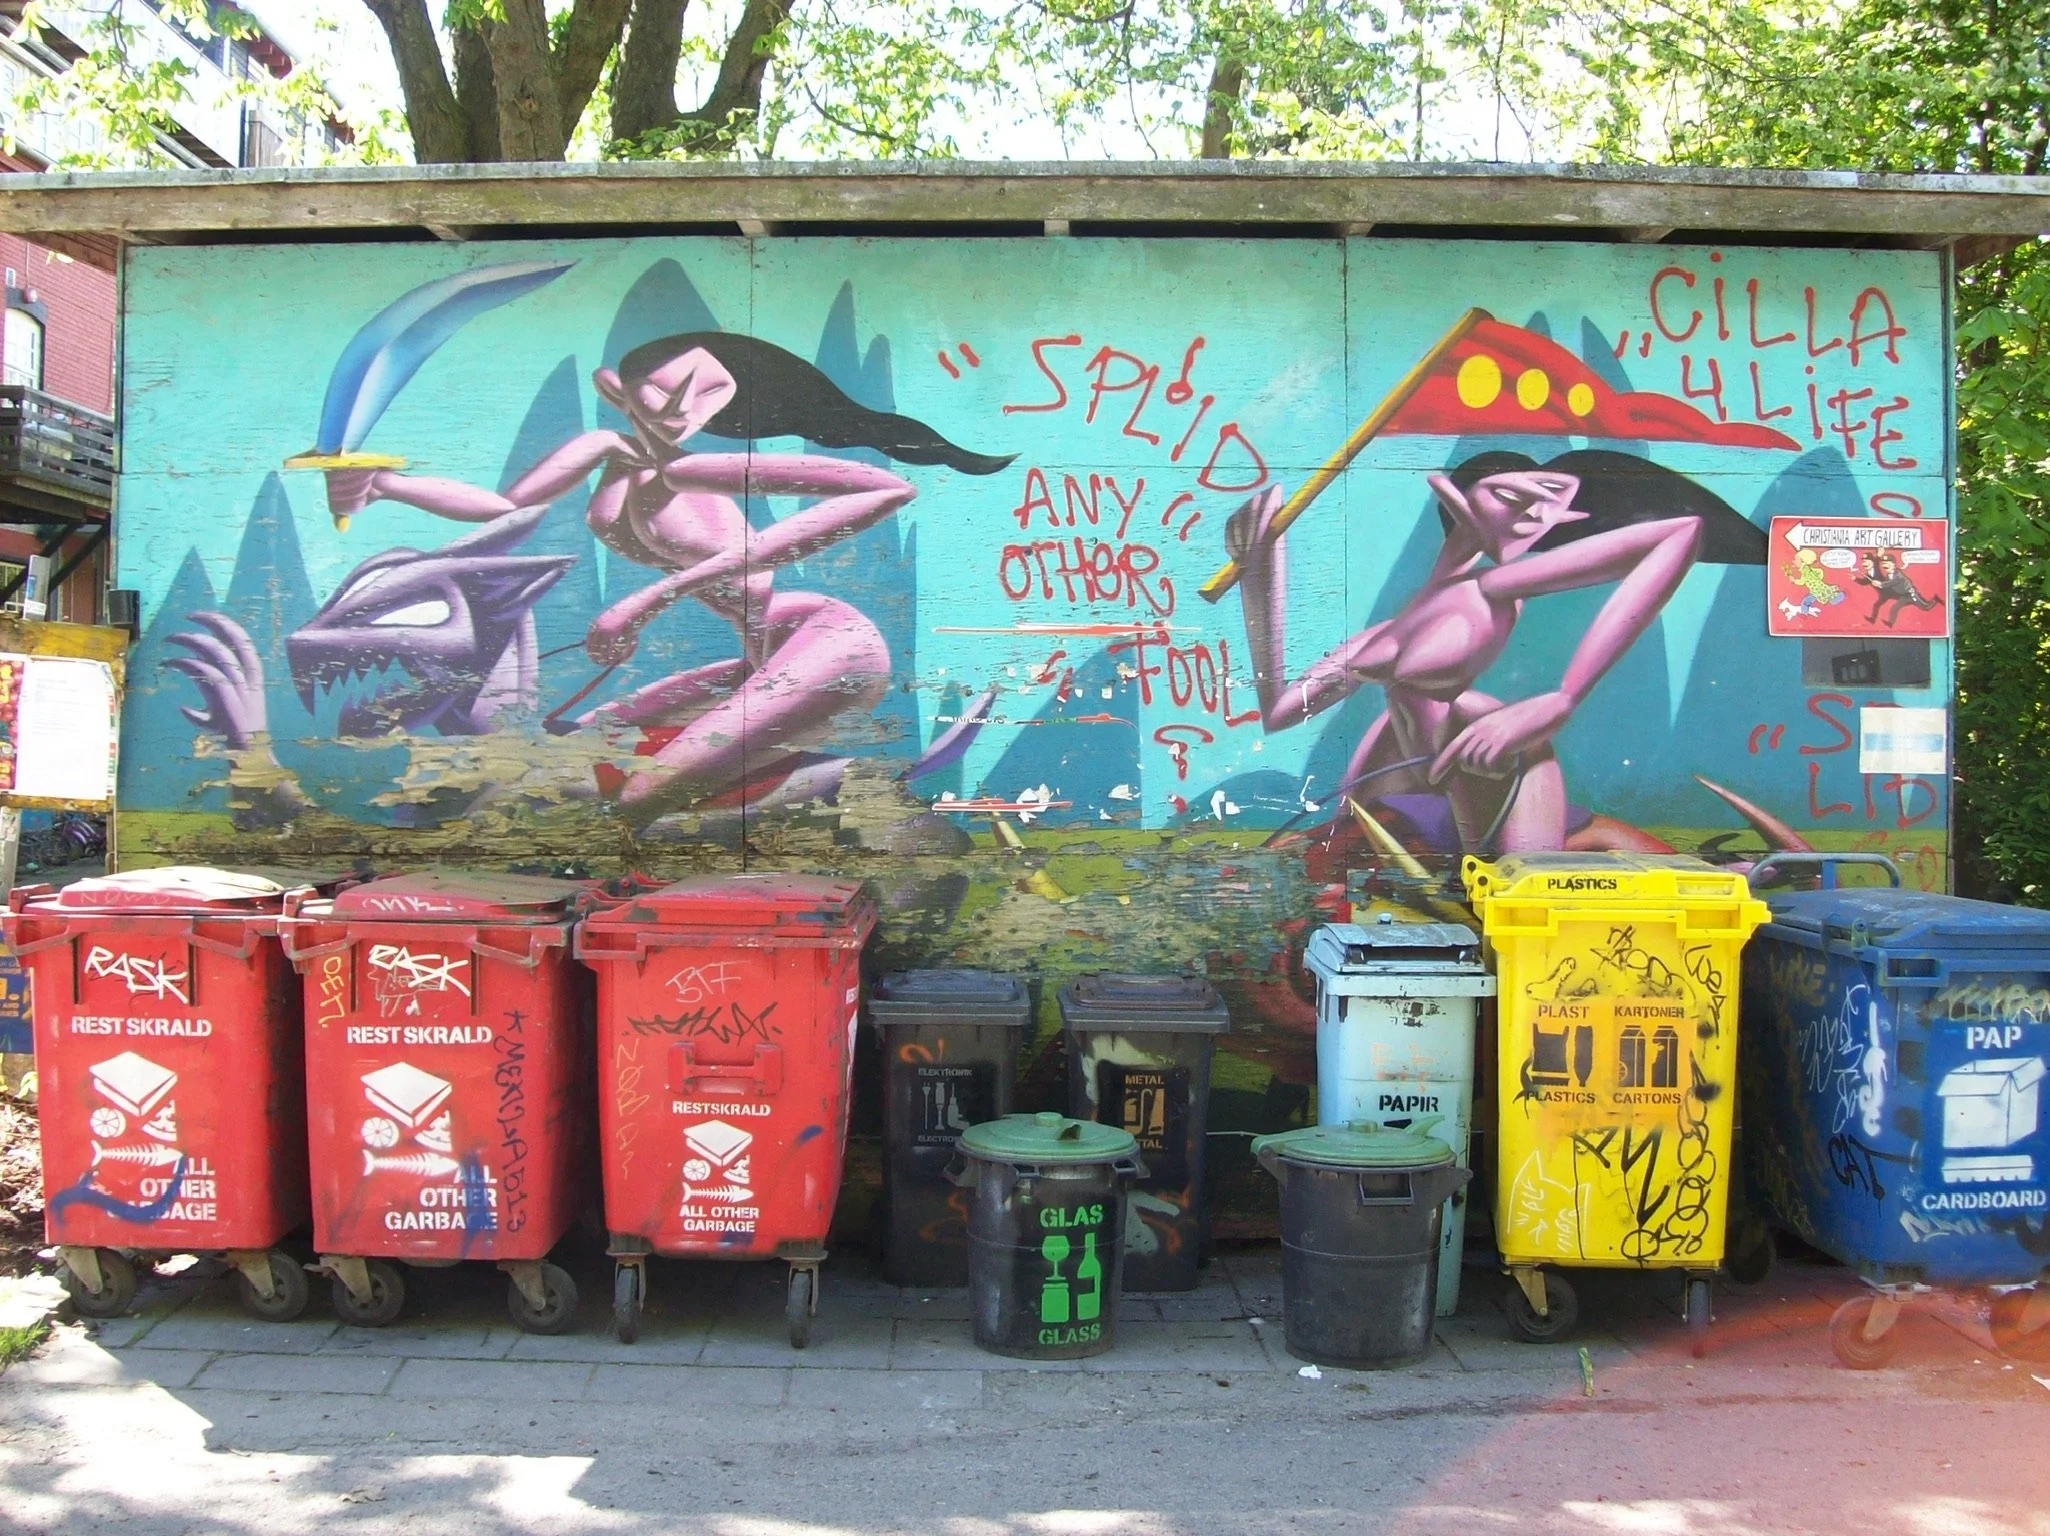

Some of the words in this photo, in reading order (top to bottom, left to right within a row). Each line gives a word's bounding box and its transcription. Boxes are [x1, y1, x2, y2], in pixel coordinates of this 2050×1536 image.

[1012, 467, 1144, 539] ANY
[1854, 529, 1872, 545] ART
[1874, 529, 1918, 547] GALLERY
[1547, 878, 1617, 890] PLASTICS
[1538, 1005, 1590, 1018] PLAST
[1966, 1027, 2021, 1049] PAP
[1125, 1074, 1164, 1086] METAL
[1379, 1094, 1439, 1112] PAPIR
[1527, 1091, 1596, 1105] PLASTICS
[1612, 1092, 1682, 1105] CARTONS
[1922, 1190, 2047, 1211] CARDBOARD
[679, 1205, 708, 1218] ALL
[710, 1206, 760, 1219] OTHER
[1040, 1204, 1104, 1228] GLAS
[683, 1220, 756, 1233] GARBAGE
[1038, 1323, 1101, 1346] GLASS
